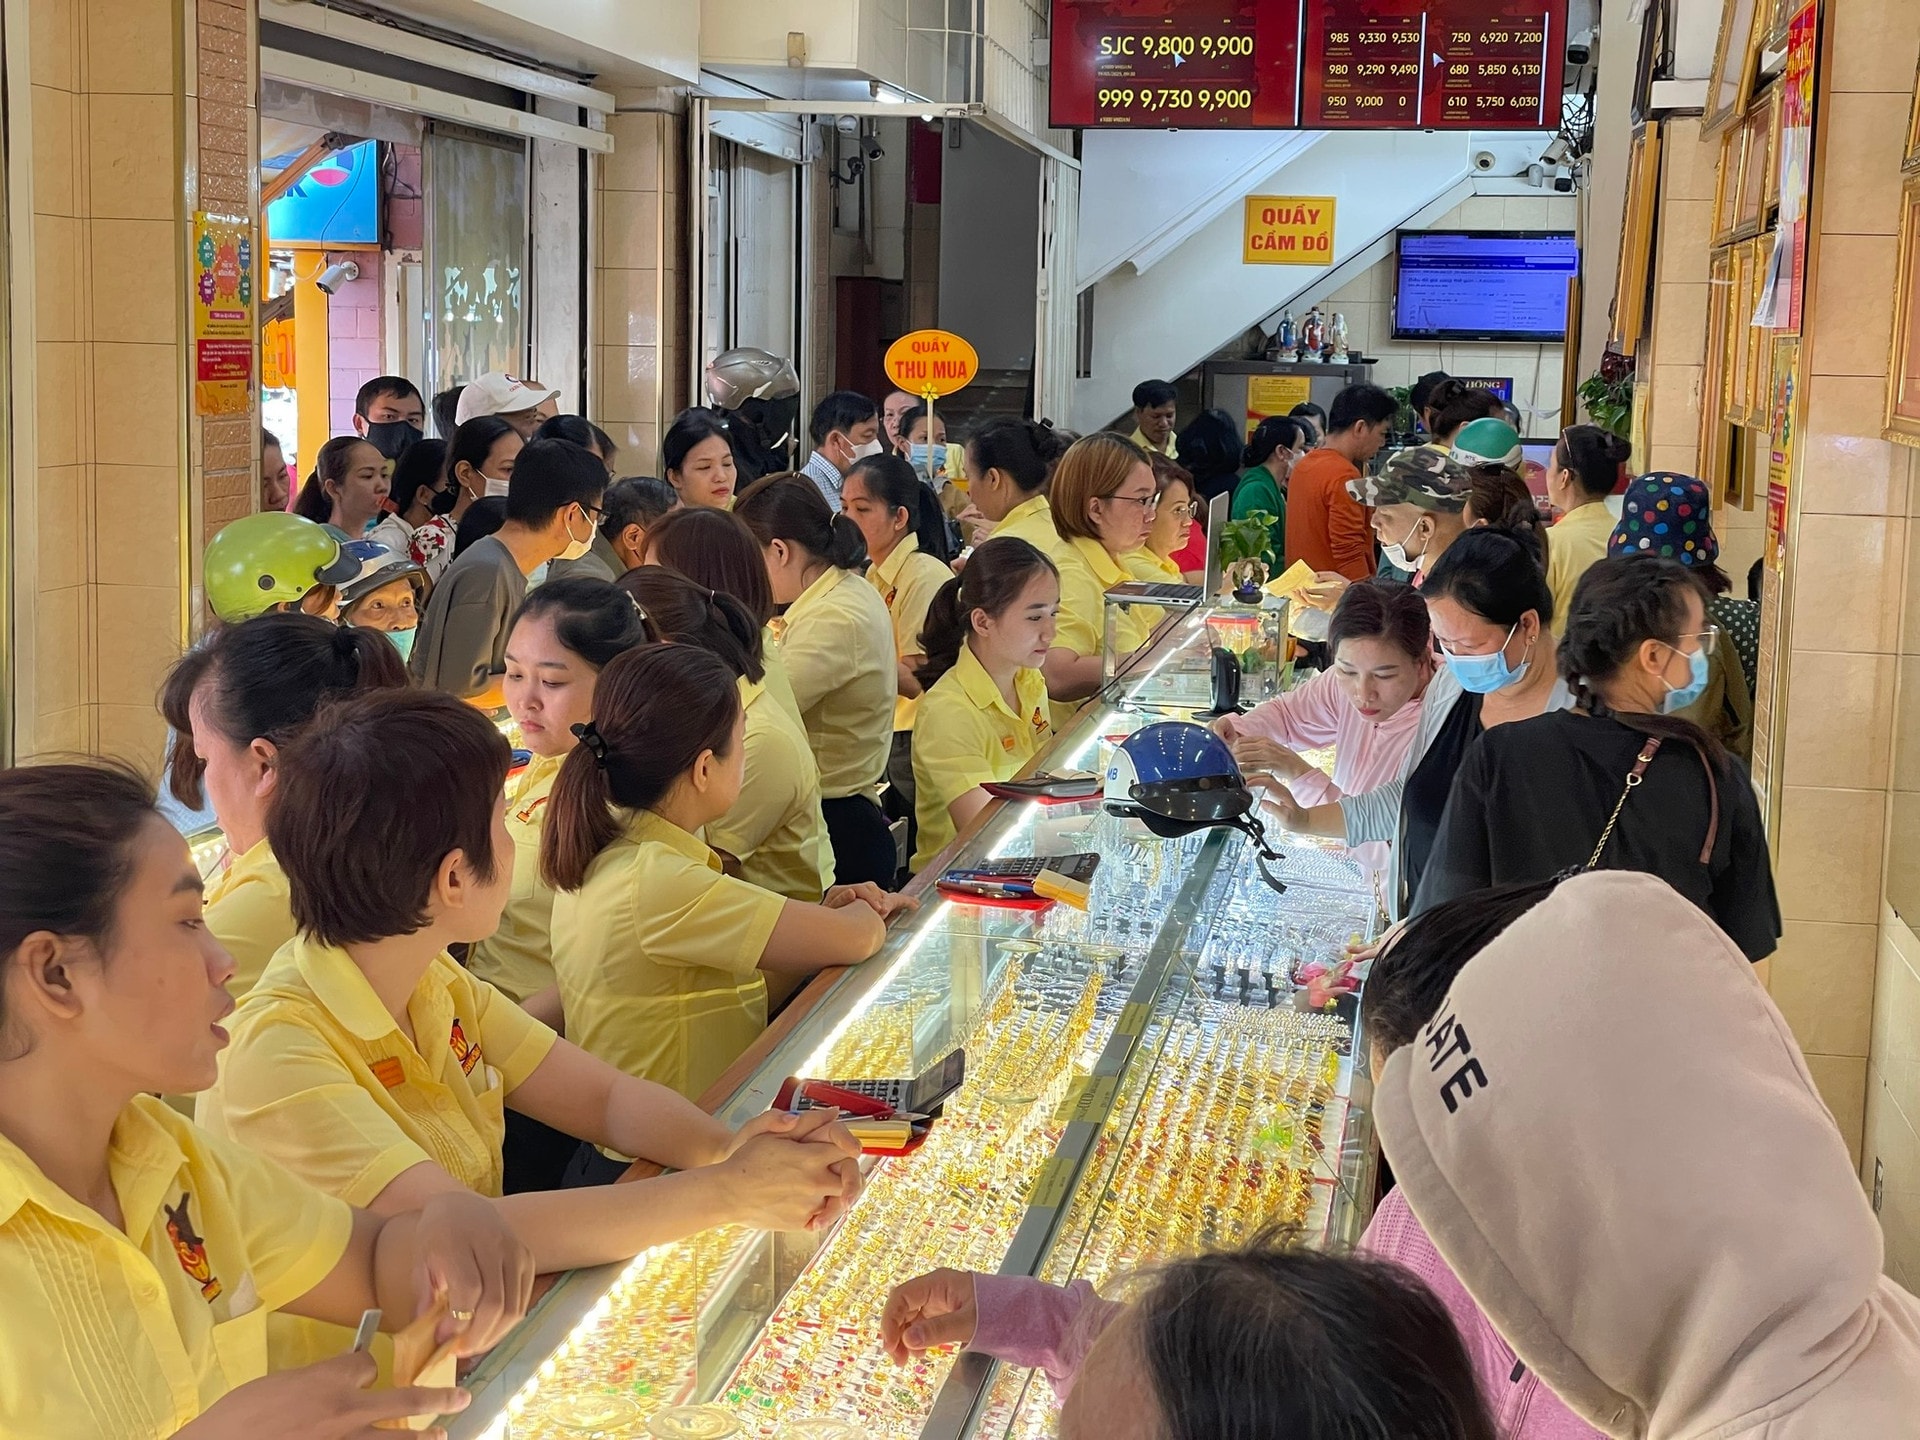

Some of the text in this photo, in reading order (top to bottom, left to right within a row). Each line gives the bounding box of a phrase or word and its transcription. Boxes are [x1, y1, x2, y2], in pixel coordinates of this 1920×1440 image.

[1330, 32, 1420, 45] 985 9,330 9,530
[1451, 32, 1543, 45] 750 6,920 7,200
[1100, 36, 1254, 59] SJC 9,800 9,900
[1329, 64, 1419, 76] 980 9,290 9,490
[1449, 64, 1541, 77] 680 5,850 6,130
[1098, 89, 1251, 112] 999 9,730 9,900
[1327, 95, 1407, 108] 950 9,000 0
[1447, 96, 1539, 108] 610 5,750 6,030
[894, 360, 968, 379] THU MUA
